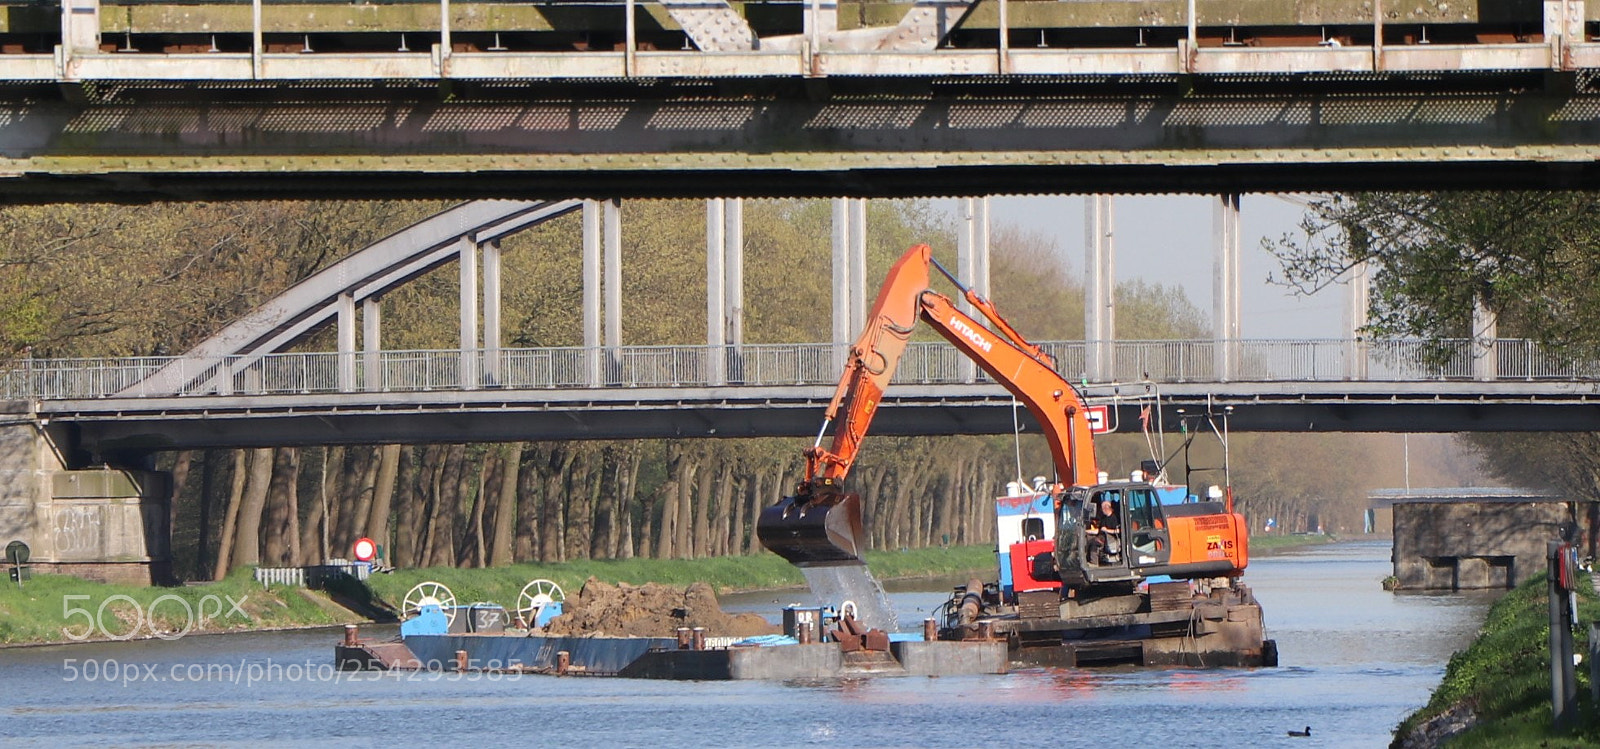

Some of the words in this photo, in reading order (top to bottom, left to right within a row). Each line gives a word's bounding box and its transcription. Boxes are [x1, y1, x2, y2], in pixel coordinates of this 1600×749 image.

[950, 316, 992, 352] HITACHI
[1207, 540, 1233, 550] ZAIS
[478, 610, 500, 628] 37
